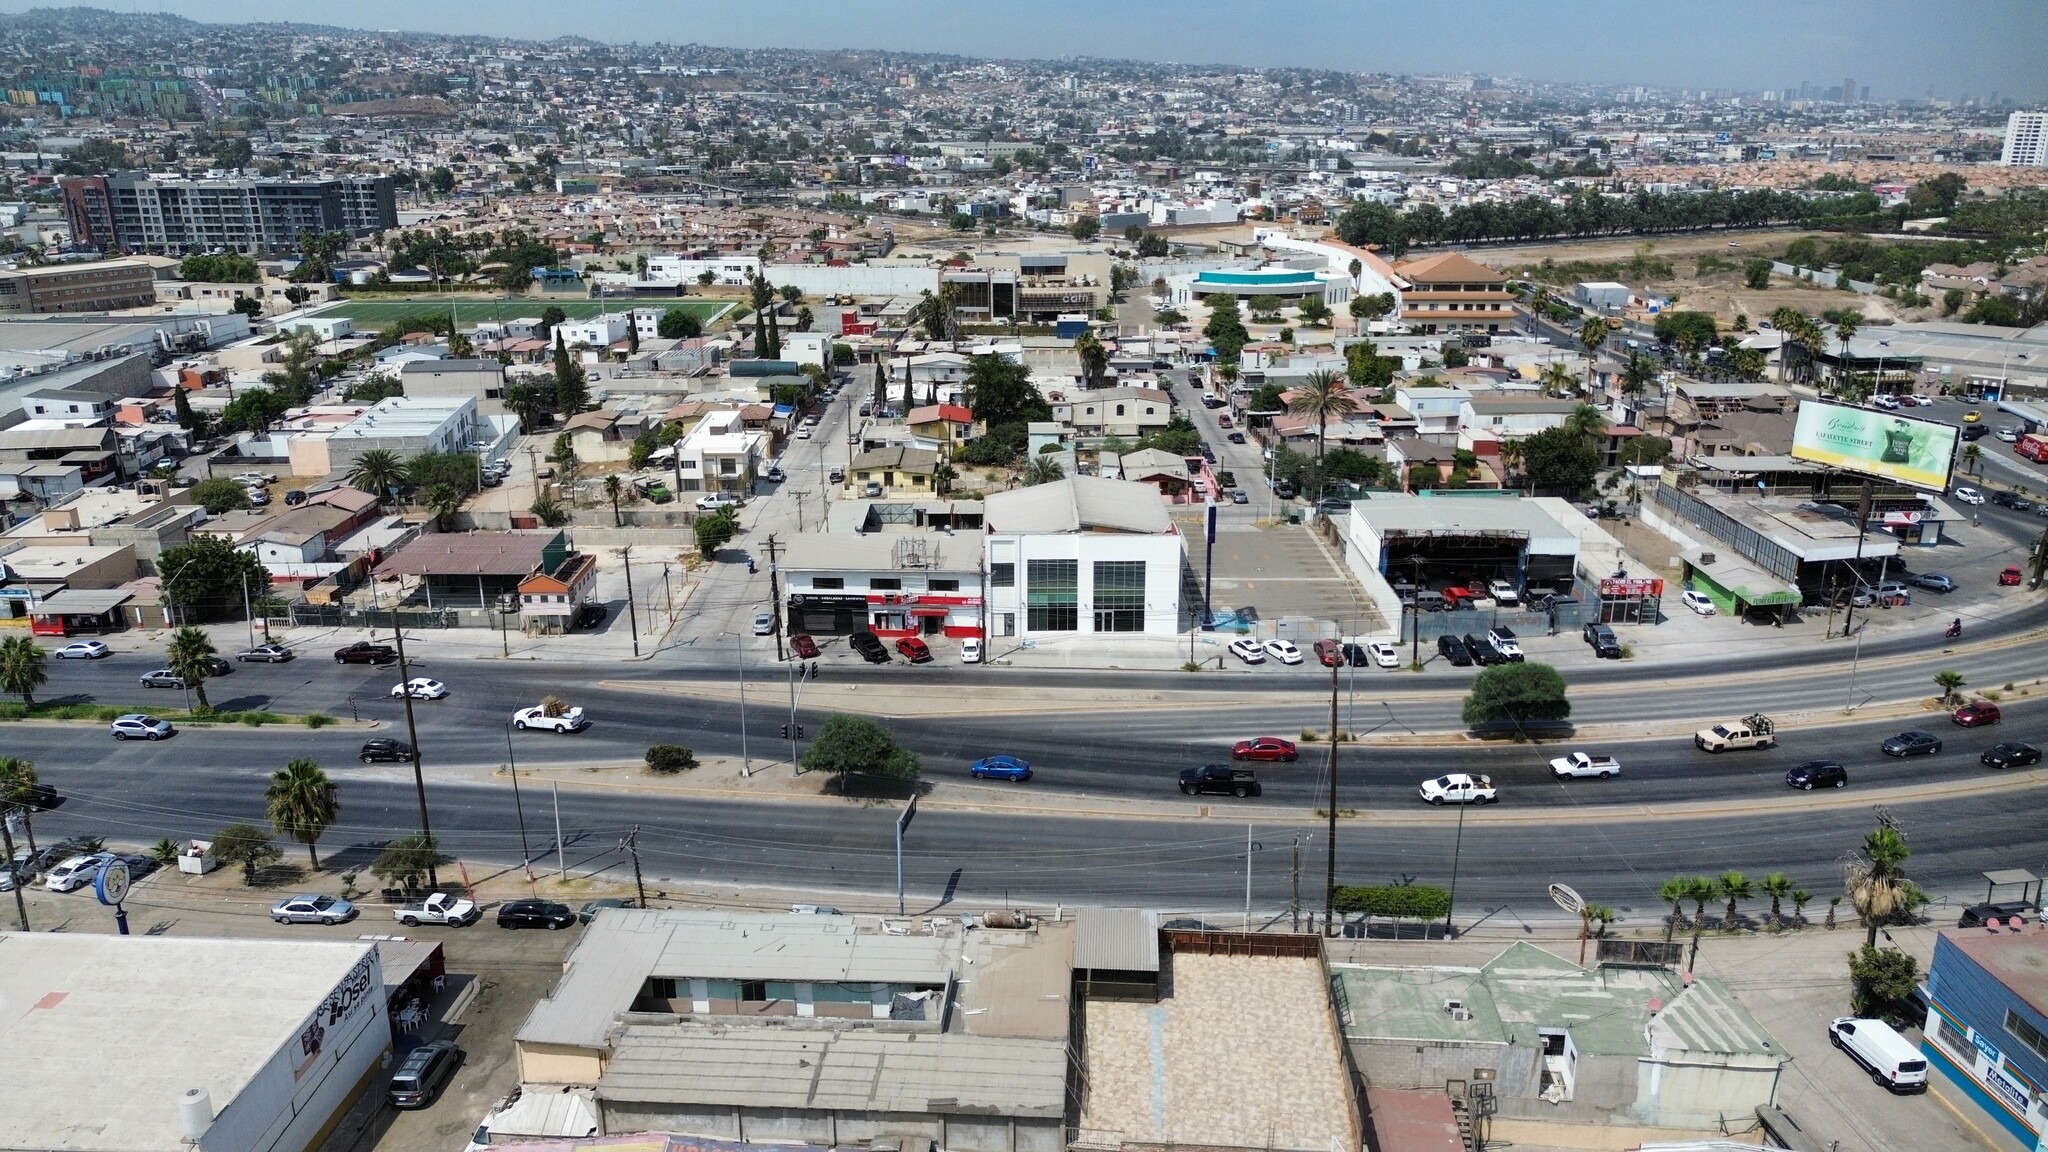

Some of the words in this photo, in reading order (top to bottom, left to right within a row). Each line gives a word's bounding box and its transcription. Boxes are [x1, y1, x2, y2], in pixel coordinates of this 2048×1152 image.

[1062, 294, 1088, 303] cdm
[1815, 431, 1848, 443] LAFAYETTE
[1849, 438, 1873, 447] STREET
[342, 964, 371, 1011] Osel
[1974, 1035, 1996, 1058] Sayer
